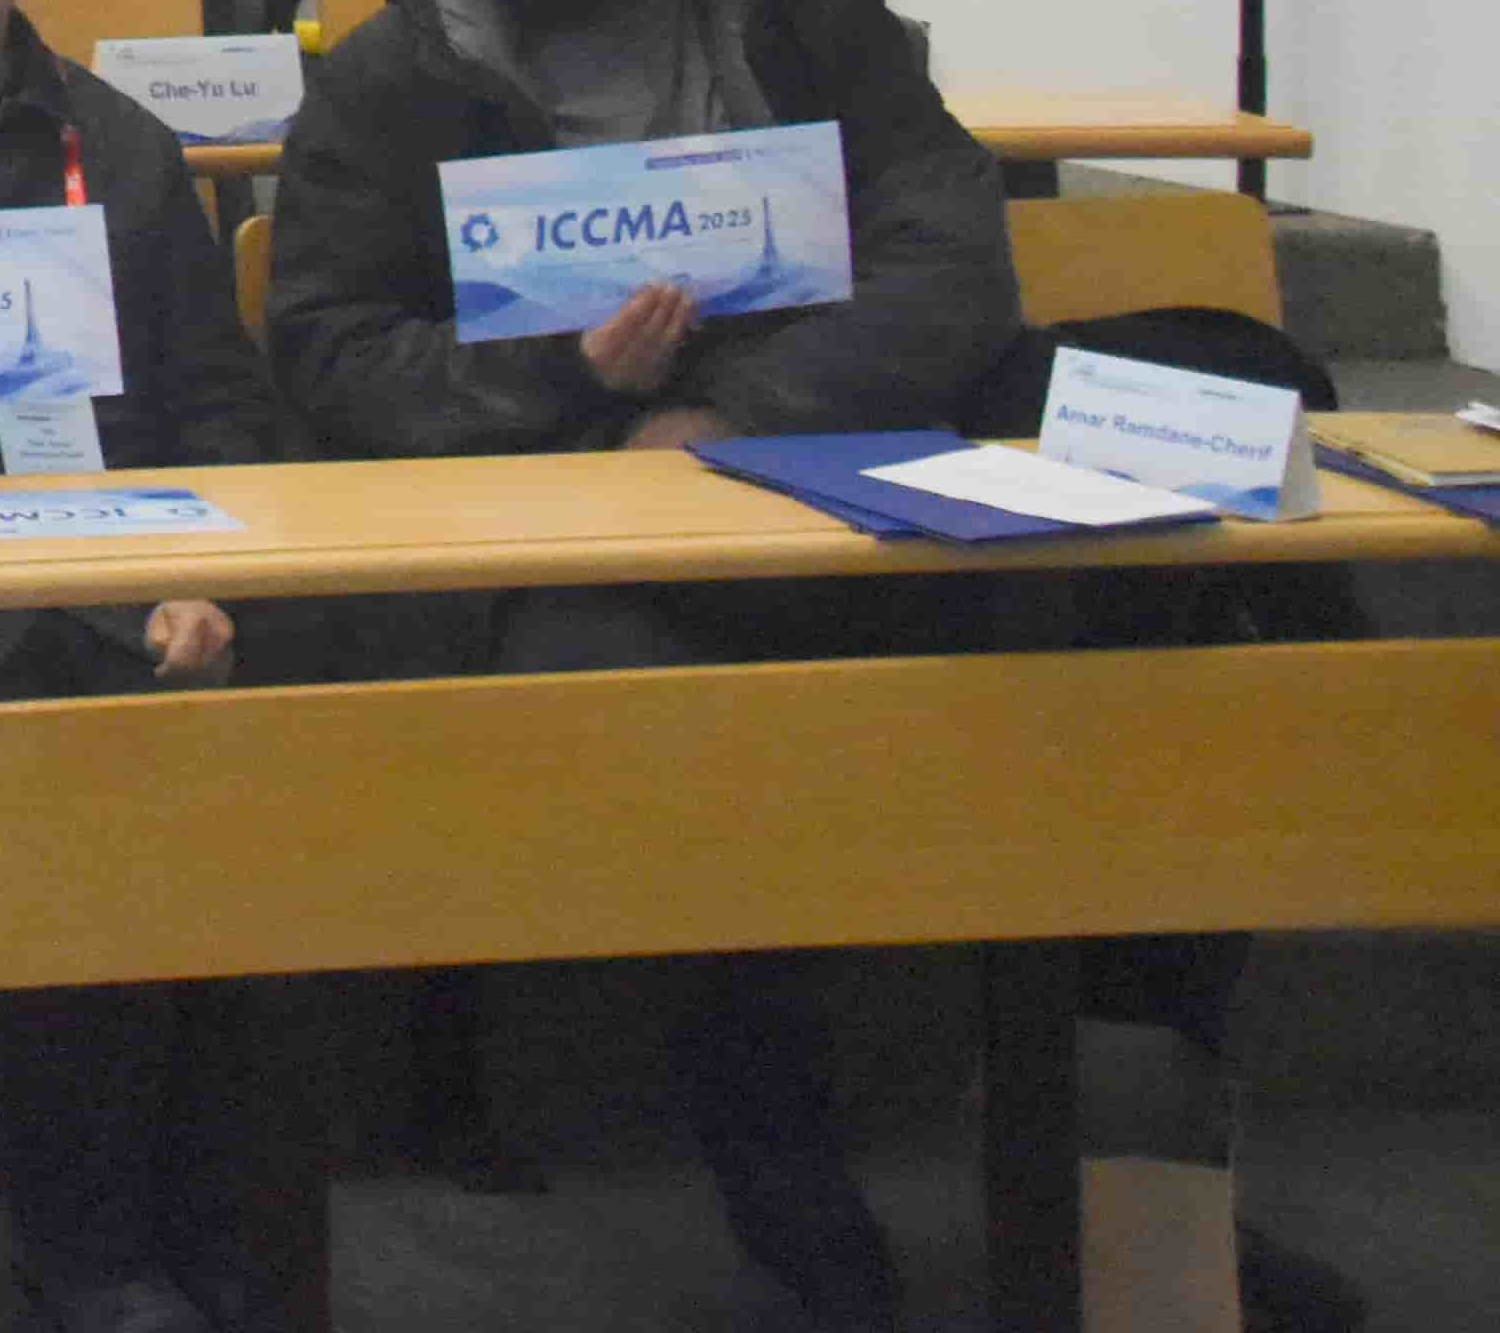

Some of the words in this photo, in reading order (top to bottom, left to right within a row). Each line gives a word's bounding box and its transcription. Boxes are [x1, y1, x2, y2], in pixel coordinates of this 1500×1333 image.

[232, 80, 257, 97] Lu
[534, 198, 694, 254] ICCMA
[698, 206, 754, 233] 2025
